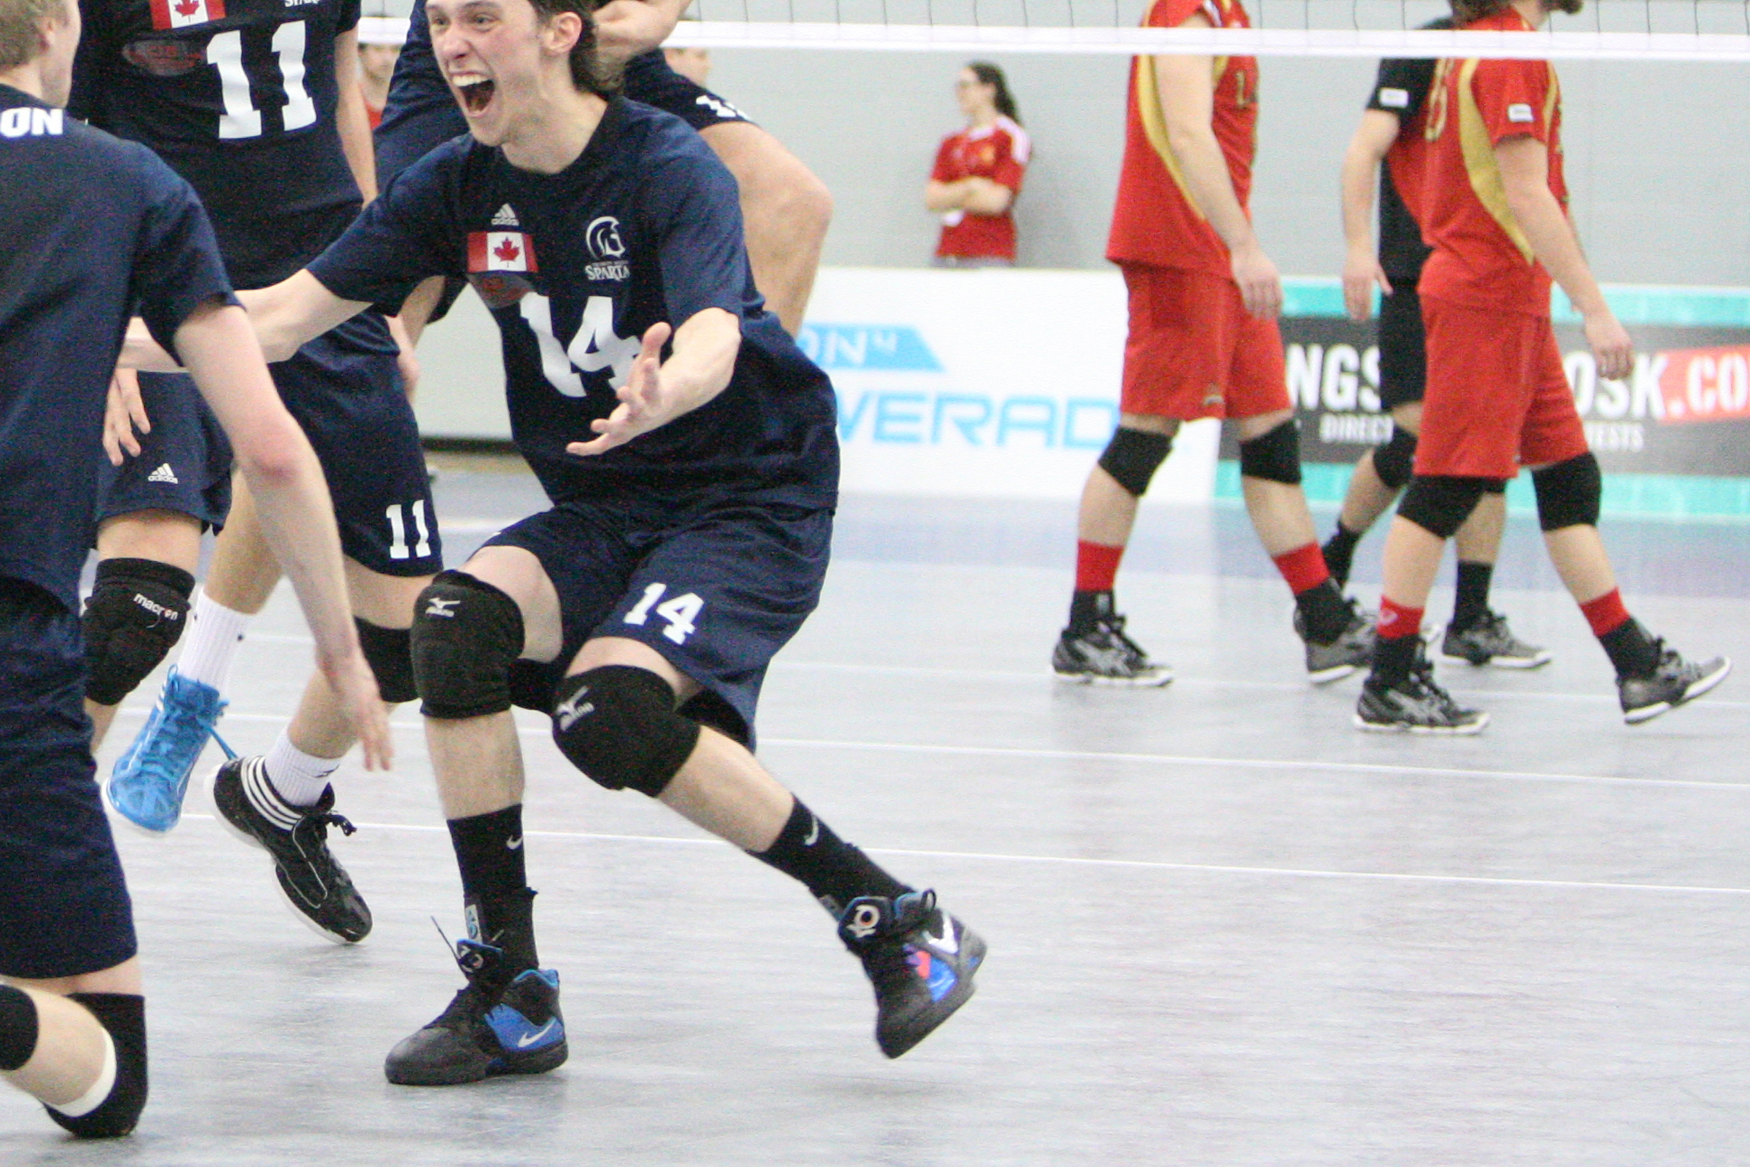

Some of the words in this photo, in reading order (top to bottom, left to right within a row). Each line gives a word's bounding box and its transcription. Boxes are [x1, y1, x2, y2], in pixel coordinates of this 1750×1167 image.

[206, 20, 317, 139] 11
[520, 291, 643, 398] 14
[385, 499, 432, 559] 11
[623, 582, 704, 645] 14
